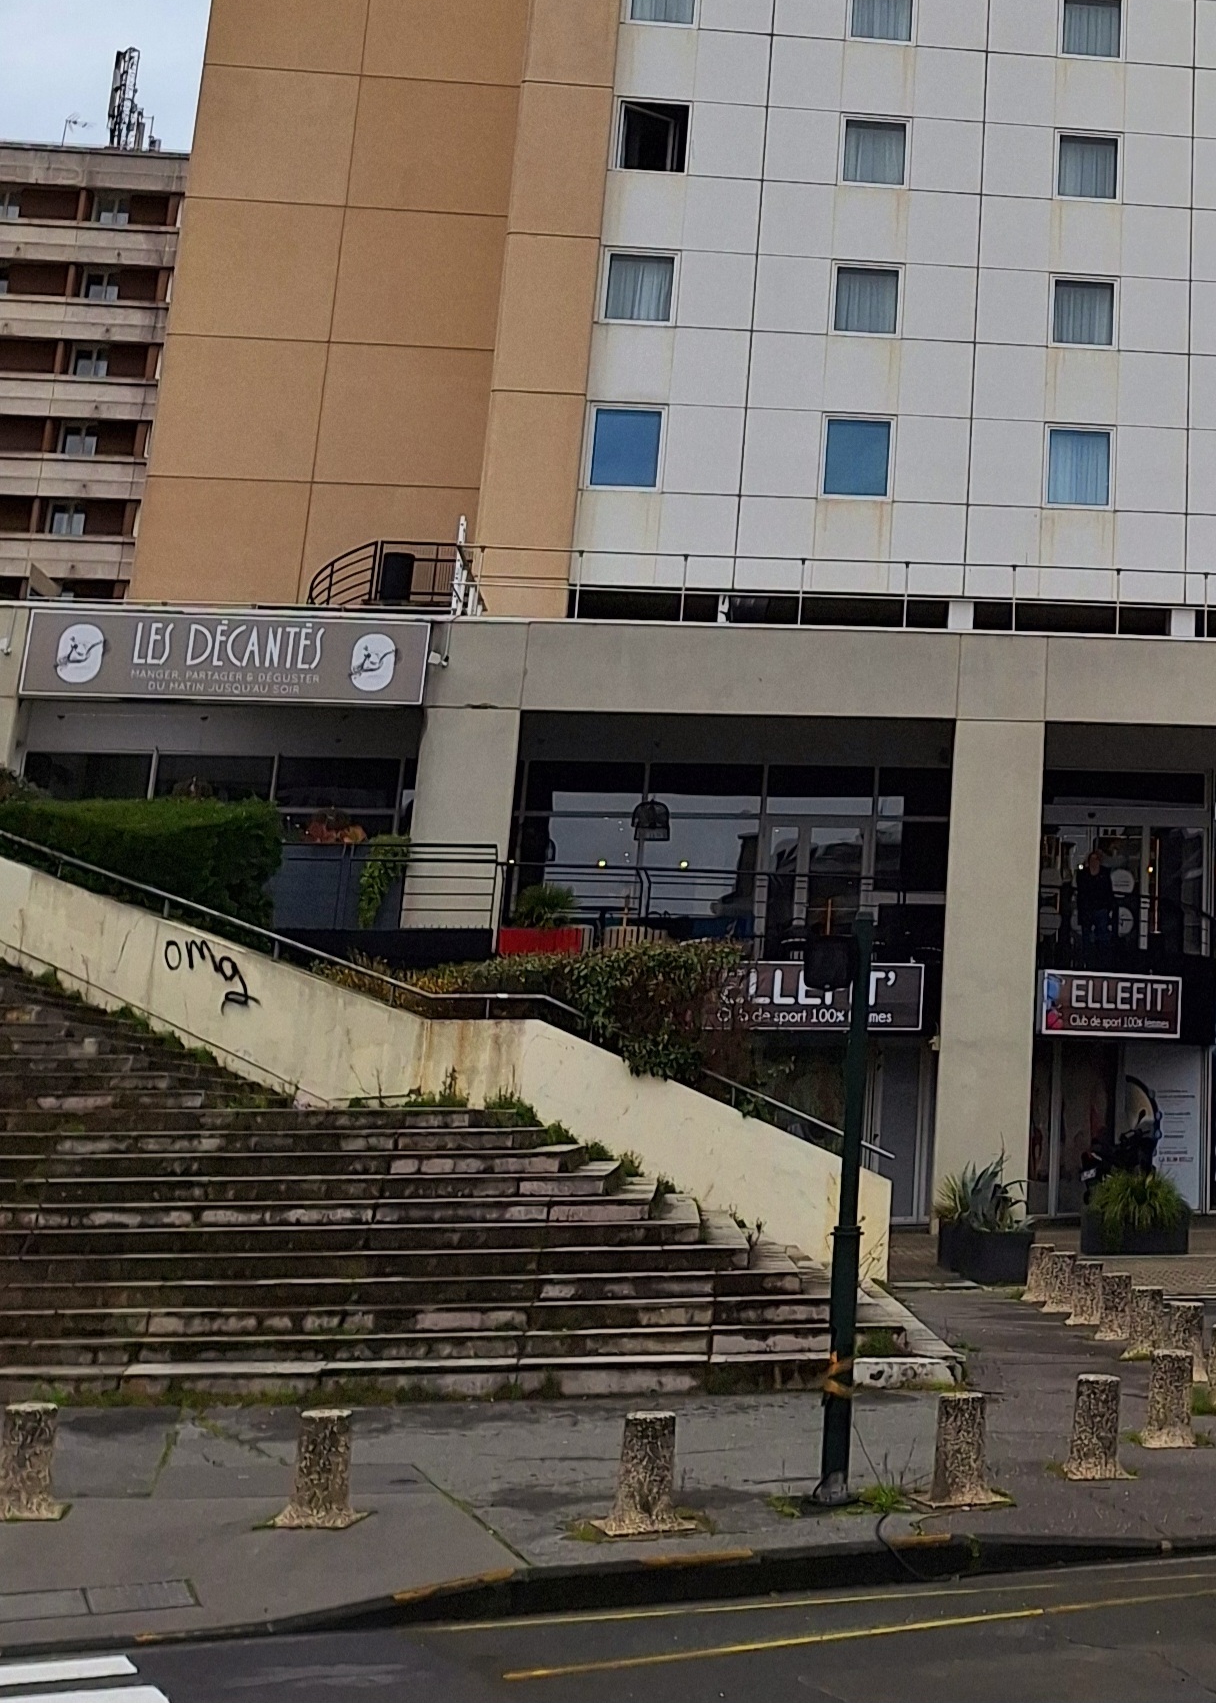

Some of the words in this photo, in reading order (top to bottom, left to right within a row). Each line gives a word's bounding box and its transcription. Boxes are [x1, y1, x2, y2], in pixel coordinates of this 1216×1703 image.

[132, 622, 174, 665] LES
[186, 620, 326, 670] DÉCANTÉS
[131, 669, 181, 681] MANGER,
[186, 671, 242, 682] PARTAGER
[258, 671, 320, 684] DÉGUSTER
[148, 681, 165, 690] DU
[170, 682, 204, 691] MATIN
[208, 683, 268, 694] JUSQU'AU
[273, 684, 300, 694] SOIR
[752, 1007, 771, 1022] de
[773, 1009, 807, 1025] sport
[1070, 1014, 1089, 1026] Club
[1090, 1015, 1101, 1027] de
[1102, 1017, 1122, 1029] sport
